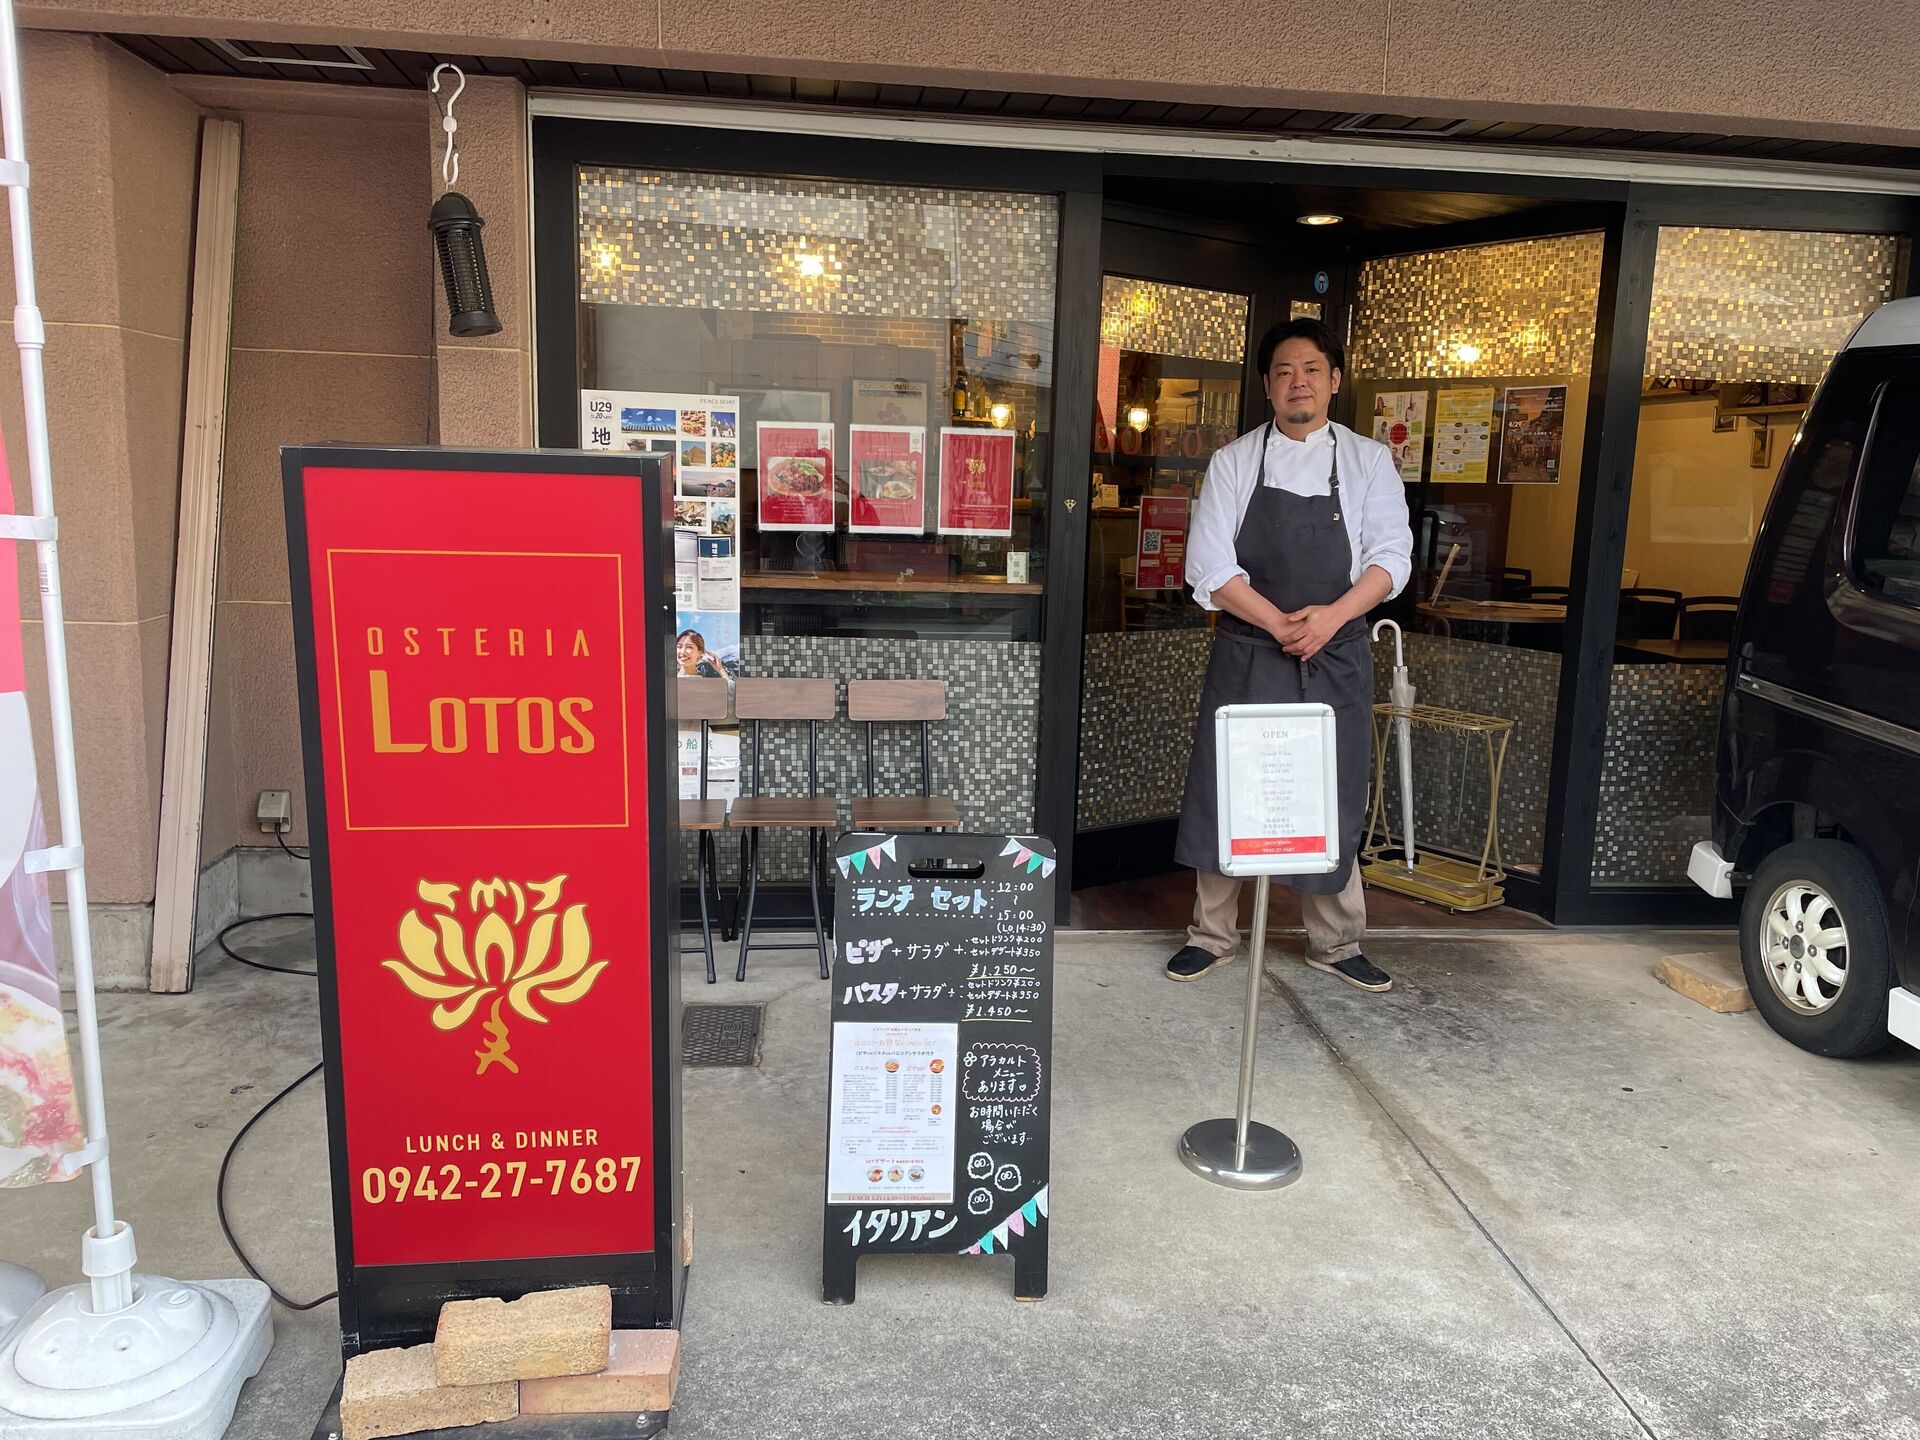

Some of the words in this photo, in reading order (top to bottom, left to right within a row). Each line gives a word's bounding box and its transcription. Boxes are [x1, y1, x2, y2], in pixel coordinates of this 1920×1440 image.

[590, 401, 612, 413] U29
[591, 426, 611, 450] 地
[367, 626, 590, 657] OSTERIA
[369, 669, 595, 754] LOTOS
[1262, 730, 1289, 739] OPEN
[996, 882, 1034, 892] 12:00
[857, 885, 915, 913] ランチ
[930, 886, 988, 914] セット
[996, 910, 1034, 920] 15:00
[980, 1054, 1027, 1068] アラカルト
[993, 1067, 1025, 1078] メニュー
[969, 1104, 1038, 1119] お時間いただく
[981, 1119, 1017, 1133] 場合が
[405, 1132, 481, 1153] LUNCH
[491, 1132, 505, 1150] &
[515, 1128, 599, 1149] DINNER
[362, 1156, 641, 1204] 0942-27-7687
[842, 1208, 959, 1247] イタリアン
